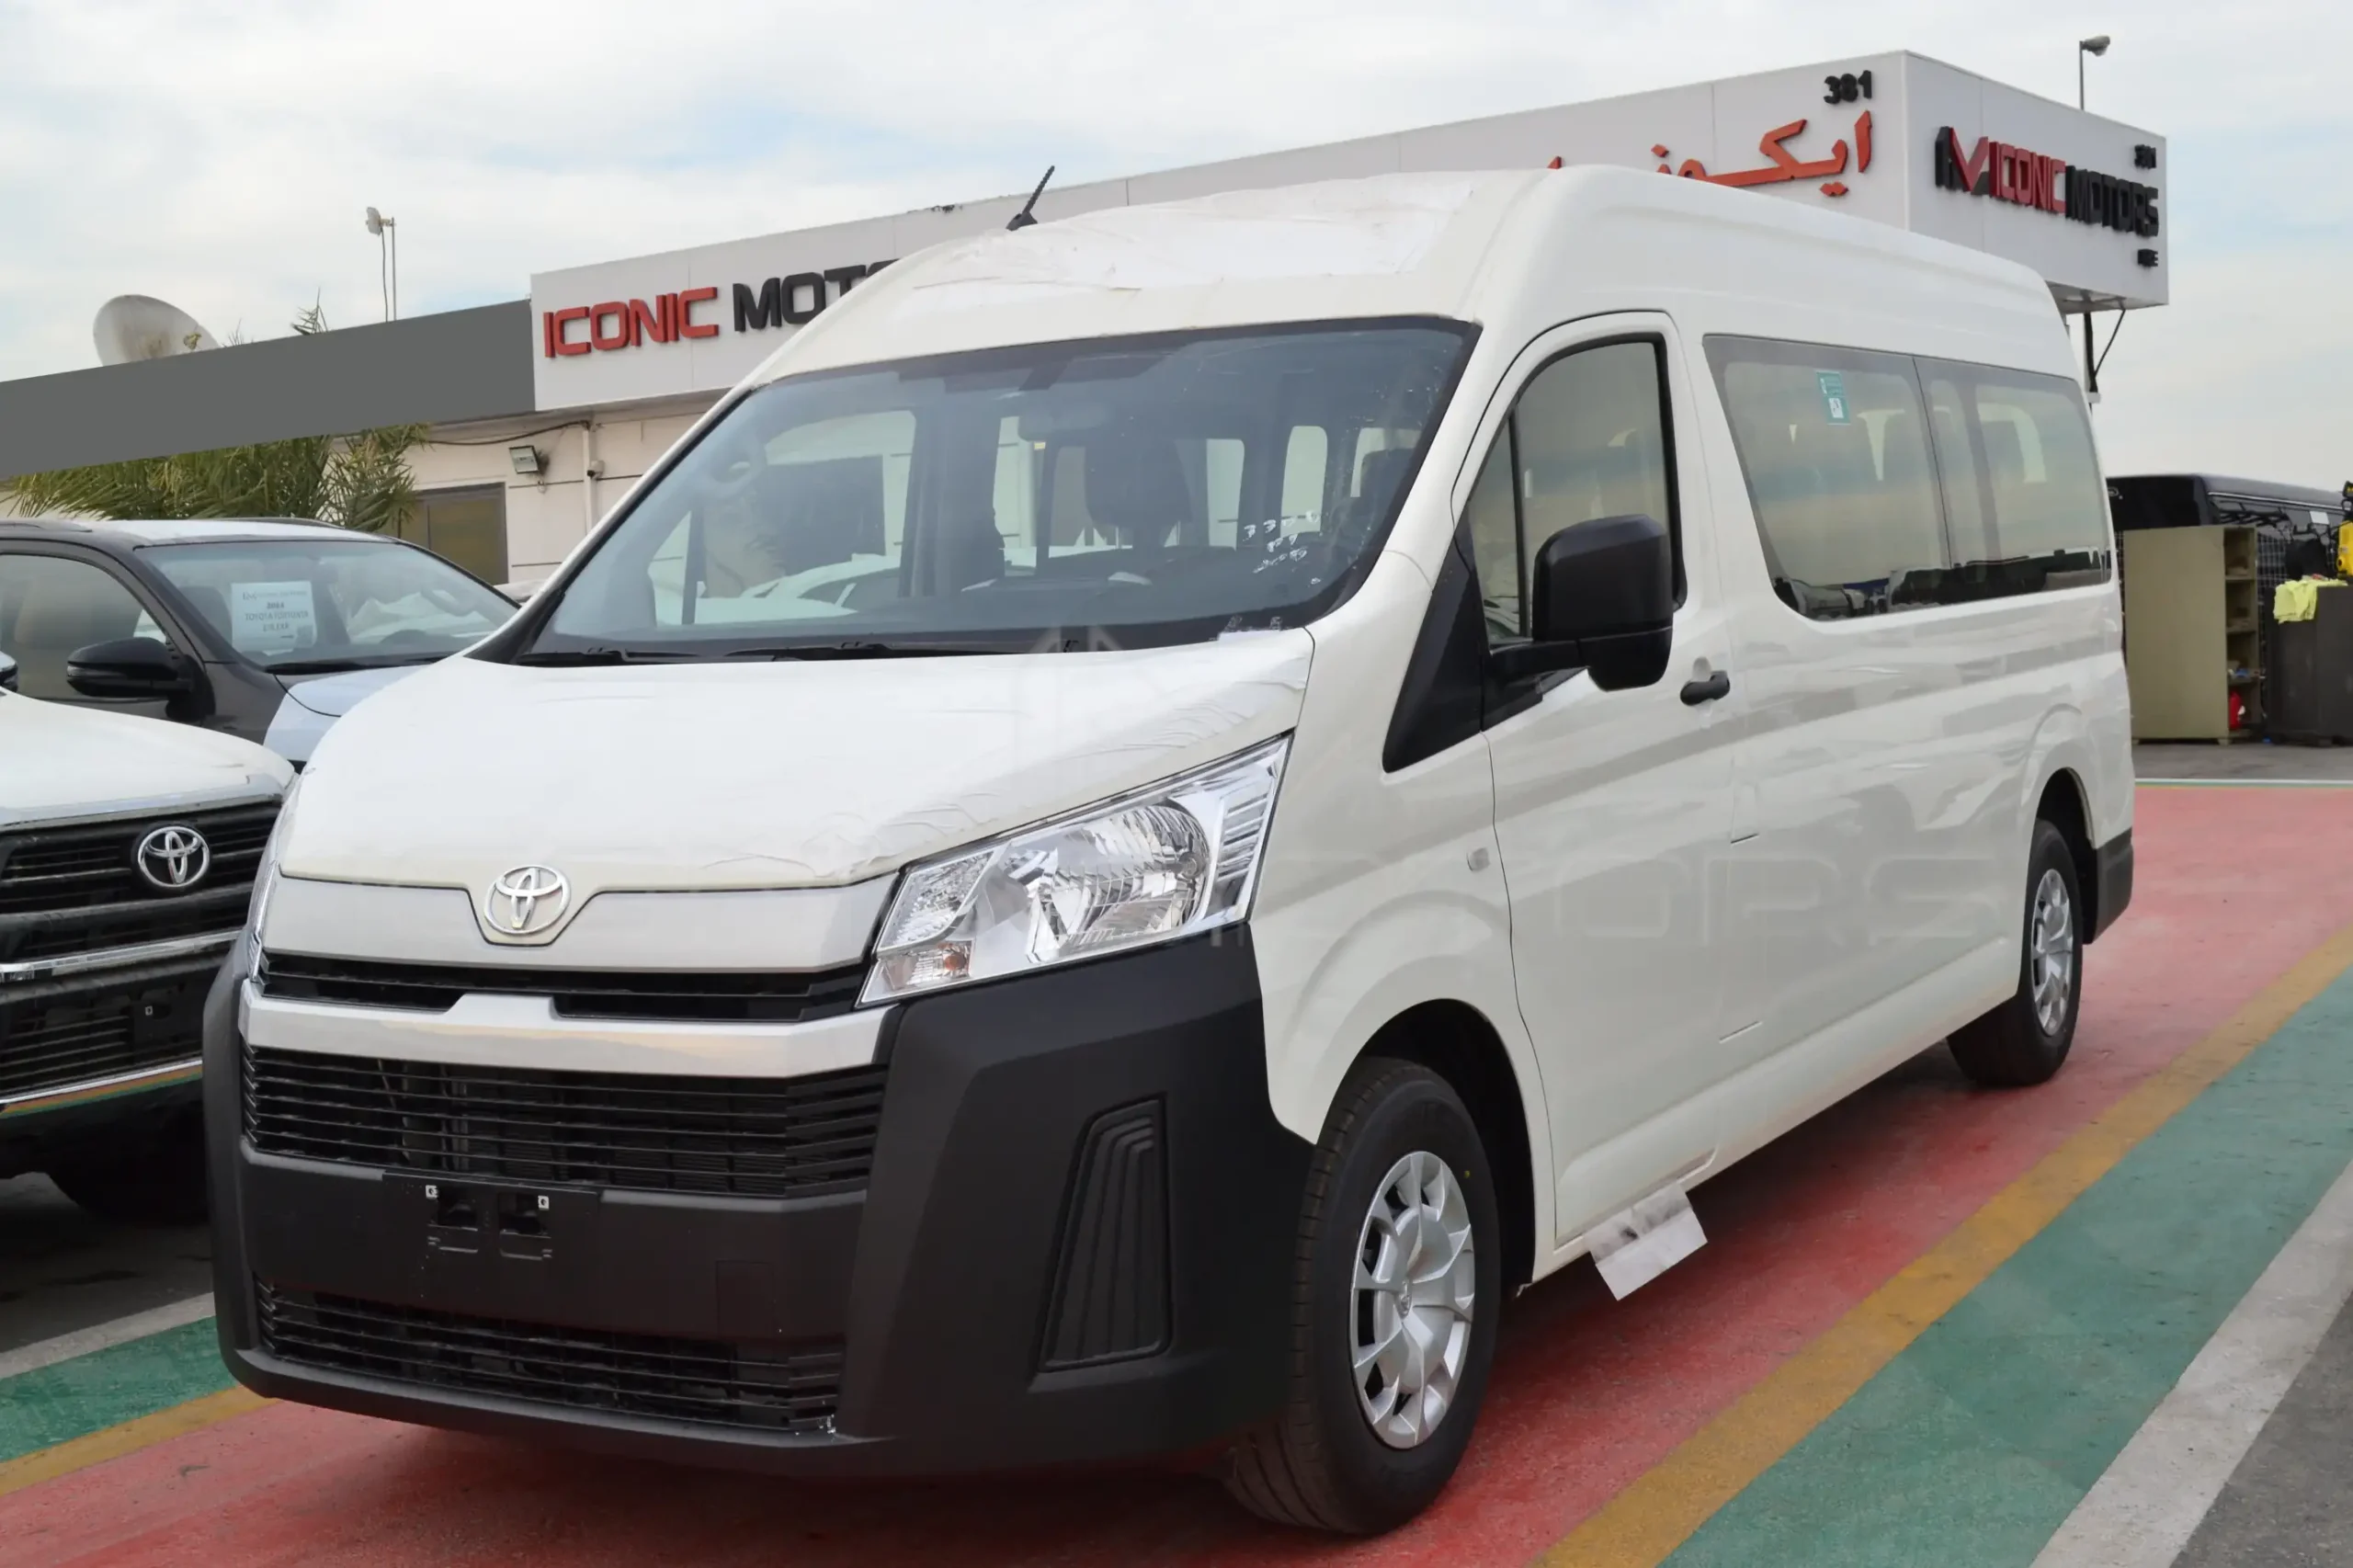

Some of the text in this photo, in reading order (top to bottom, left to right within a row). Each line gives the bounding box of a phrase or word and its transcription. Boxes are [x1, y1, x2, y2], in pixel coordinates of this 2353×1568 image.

[1823, 70, 1872, 105] 381
[1988, 141, 2066, 215] ICONIC
[2064, 165, 2159, 238] MOTORS
[543, 257, 900, 358] ICONIC MOT
